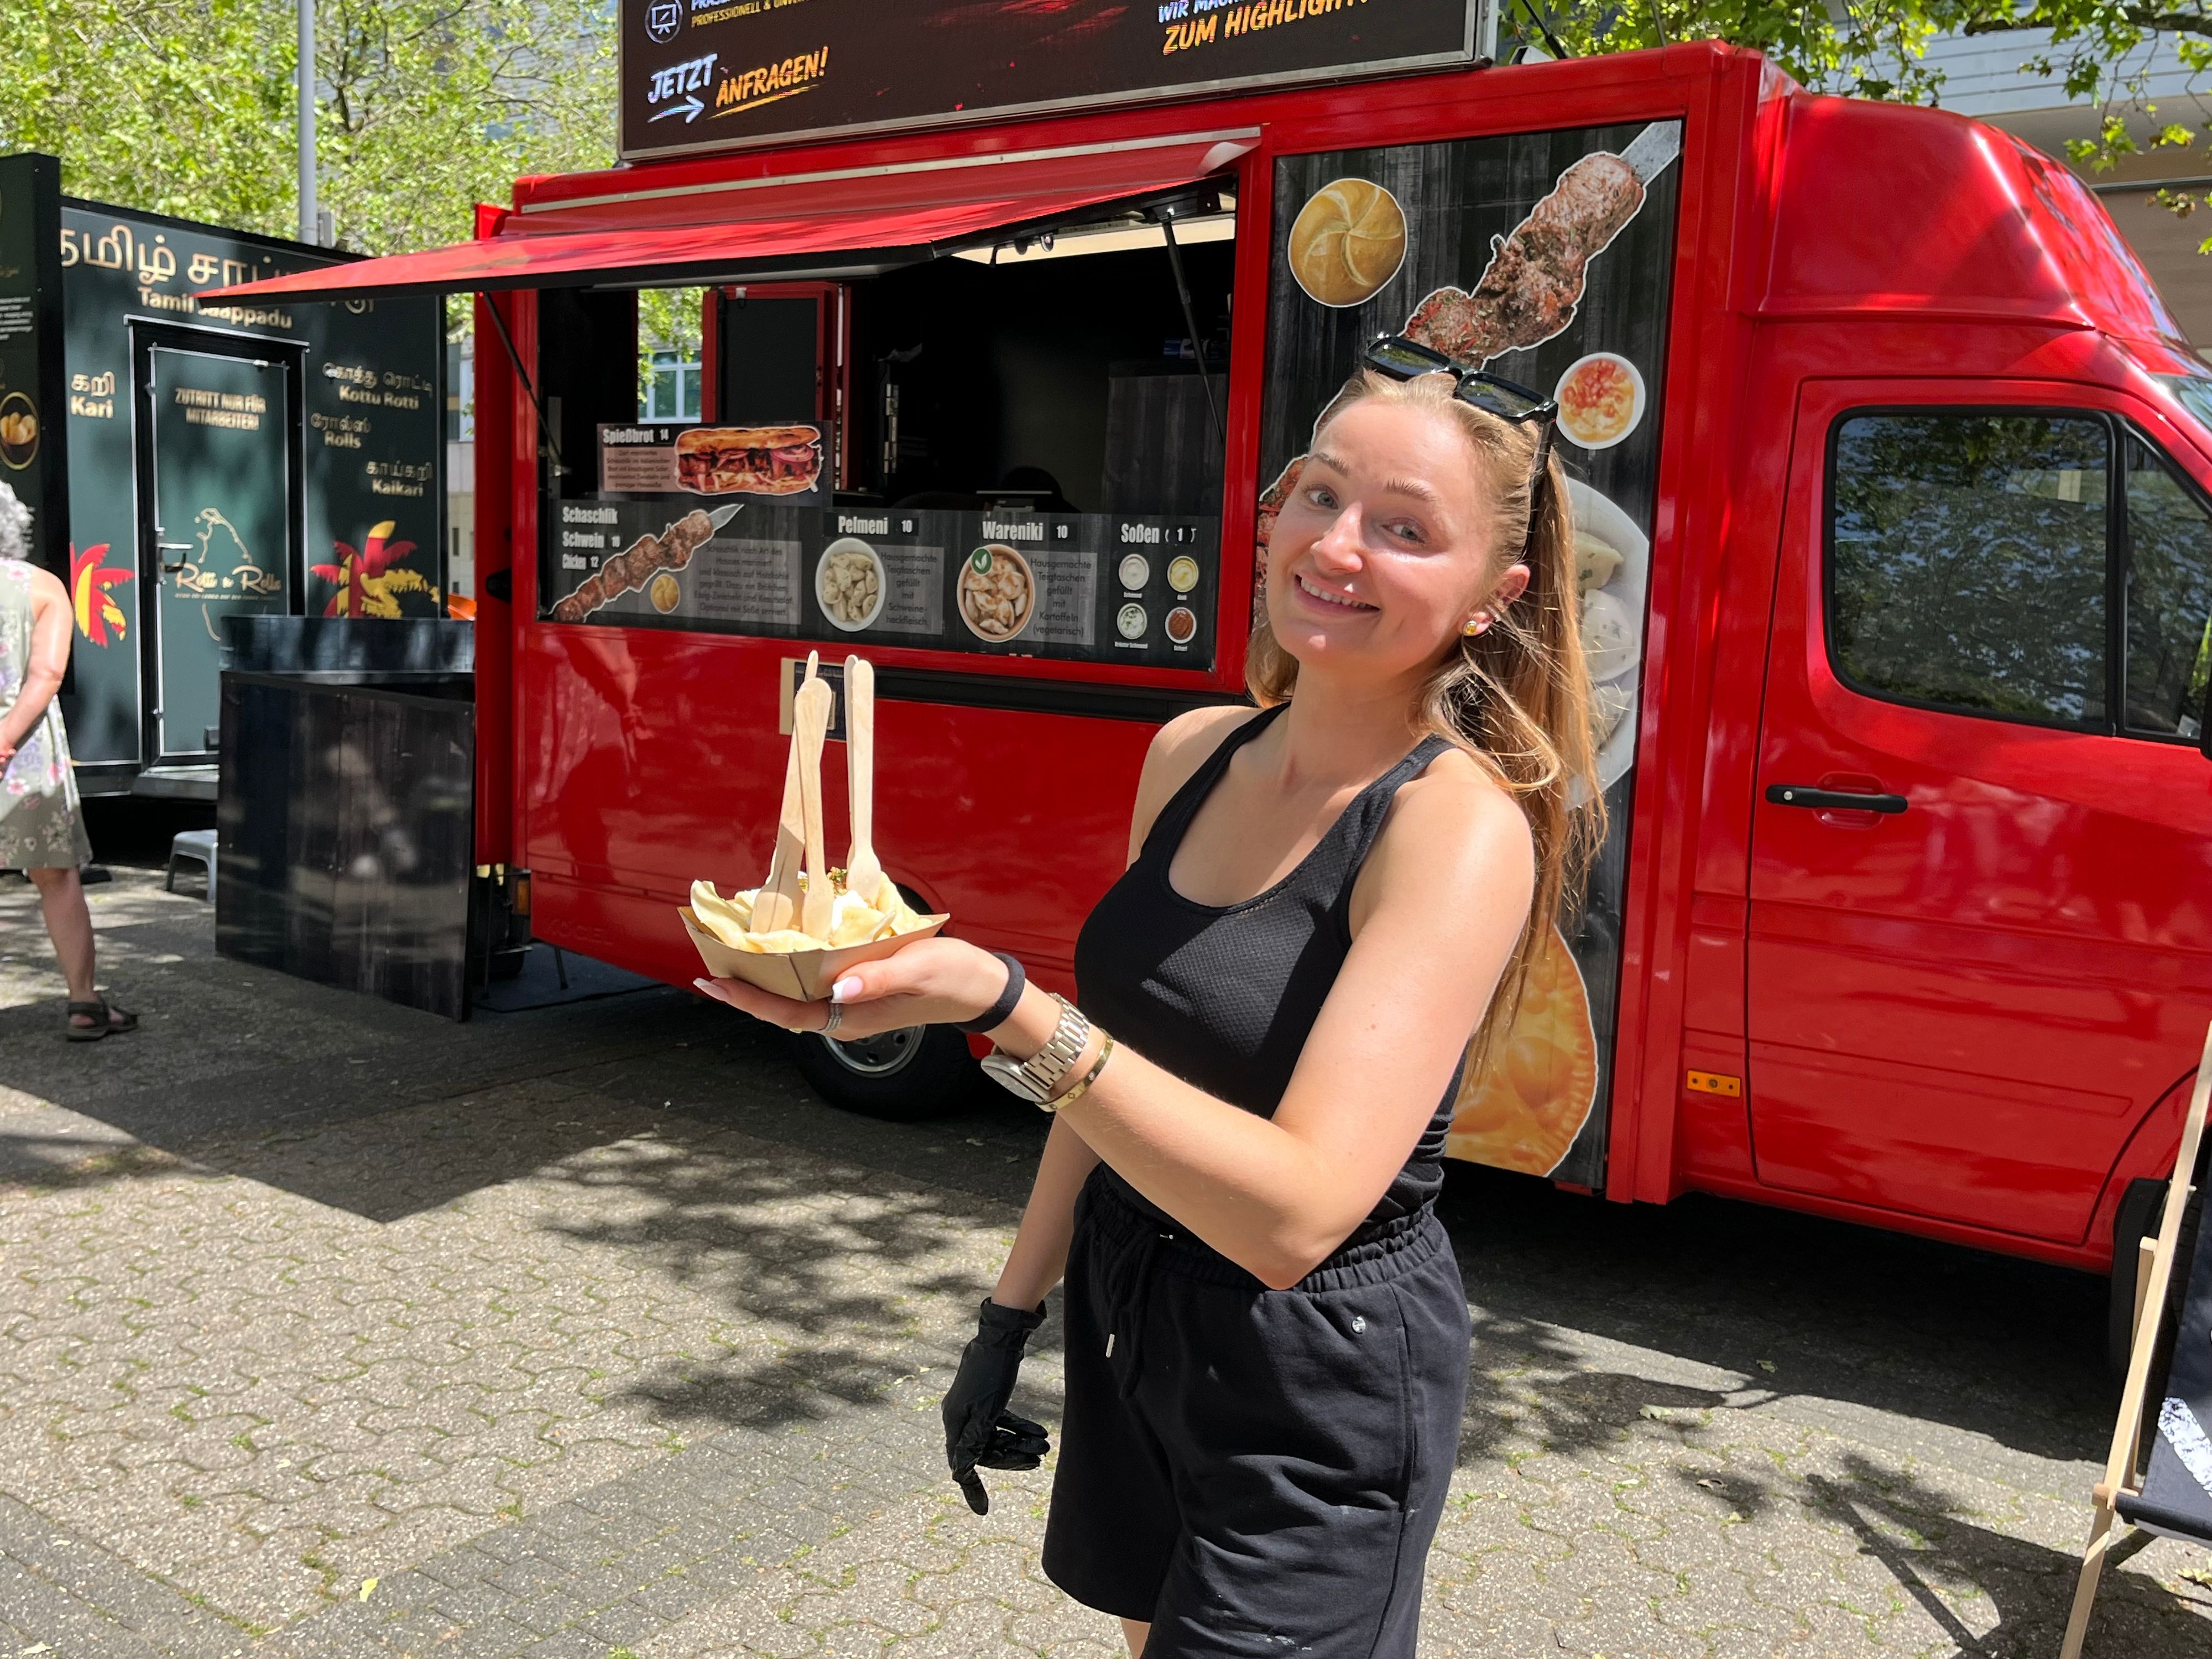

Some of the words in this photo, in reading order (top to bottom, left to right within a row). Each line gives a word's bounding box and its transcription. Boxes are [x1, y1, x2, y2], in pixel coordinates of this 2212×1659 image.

[691, 1, 760, 27] PROFESSIONELL
[1158, 0, 1188, 23] WIR
[1162, 14, 1218, 55] ZUM
[647, 53, 718, 104] JETZT
[716, 45, 829, 108] ANFRAGEN!
[137, 286, 195, 314] Tamil
[175, 388, 221, 408] ZUTRITT
[339, 384, 381, 405] Kottu
[384, 391, 420, 410] Rotti
[70, 395, 113, 419] Kari
[325, 431, 362, 448] Rolls
[603, 428, 655, 445] Spießbrot
[660, 428, 670, 441] 14
[372, 479, 424, 497] Kaikari
[562, 506, 618, 524] Schaschlik
[838, 515, 888, 535] Pelmeni
[901, 520, 912, 533] 10
[982, 521, 1043, 541] Wareniki
[1056, 525, 1068, 539] 10
[1121, 524, 1160, 544] Soßen
[562, 531, 604, 548] Schwein
[880, 554, 937, 564] Hausgemachte
[1031, 559, 1092, 570] Hausgemachte
[888, 565, 930, 576] Teigtaschen
[1038, 572, 1085, 583] Teigtaschen
[1047, 586, 1072, 596] gefüllt
[1039, 612, 1078, 622] Kartoffeln
[1033, 625, 1084, 638] (vegetarisch)
